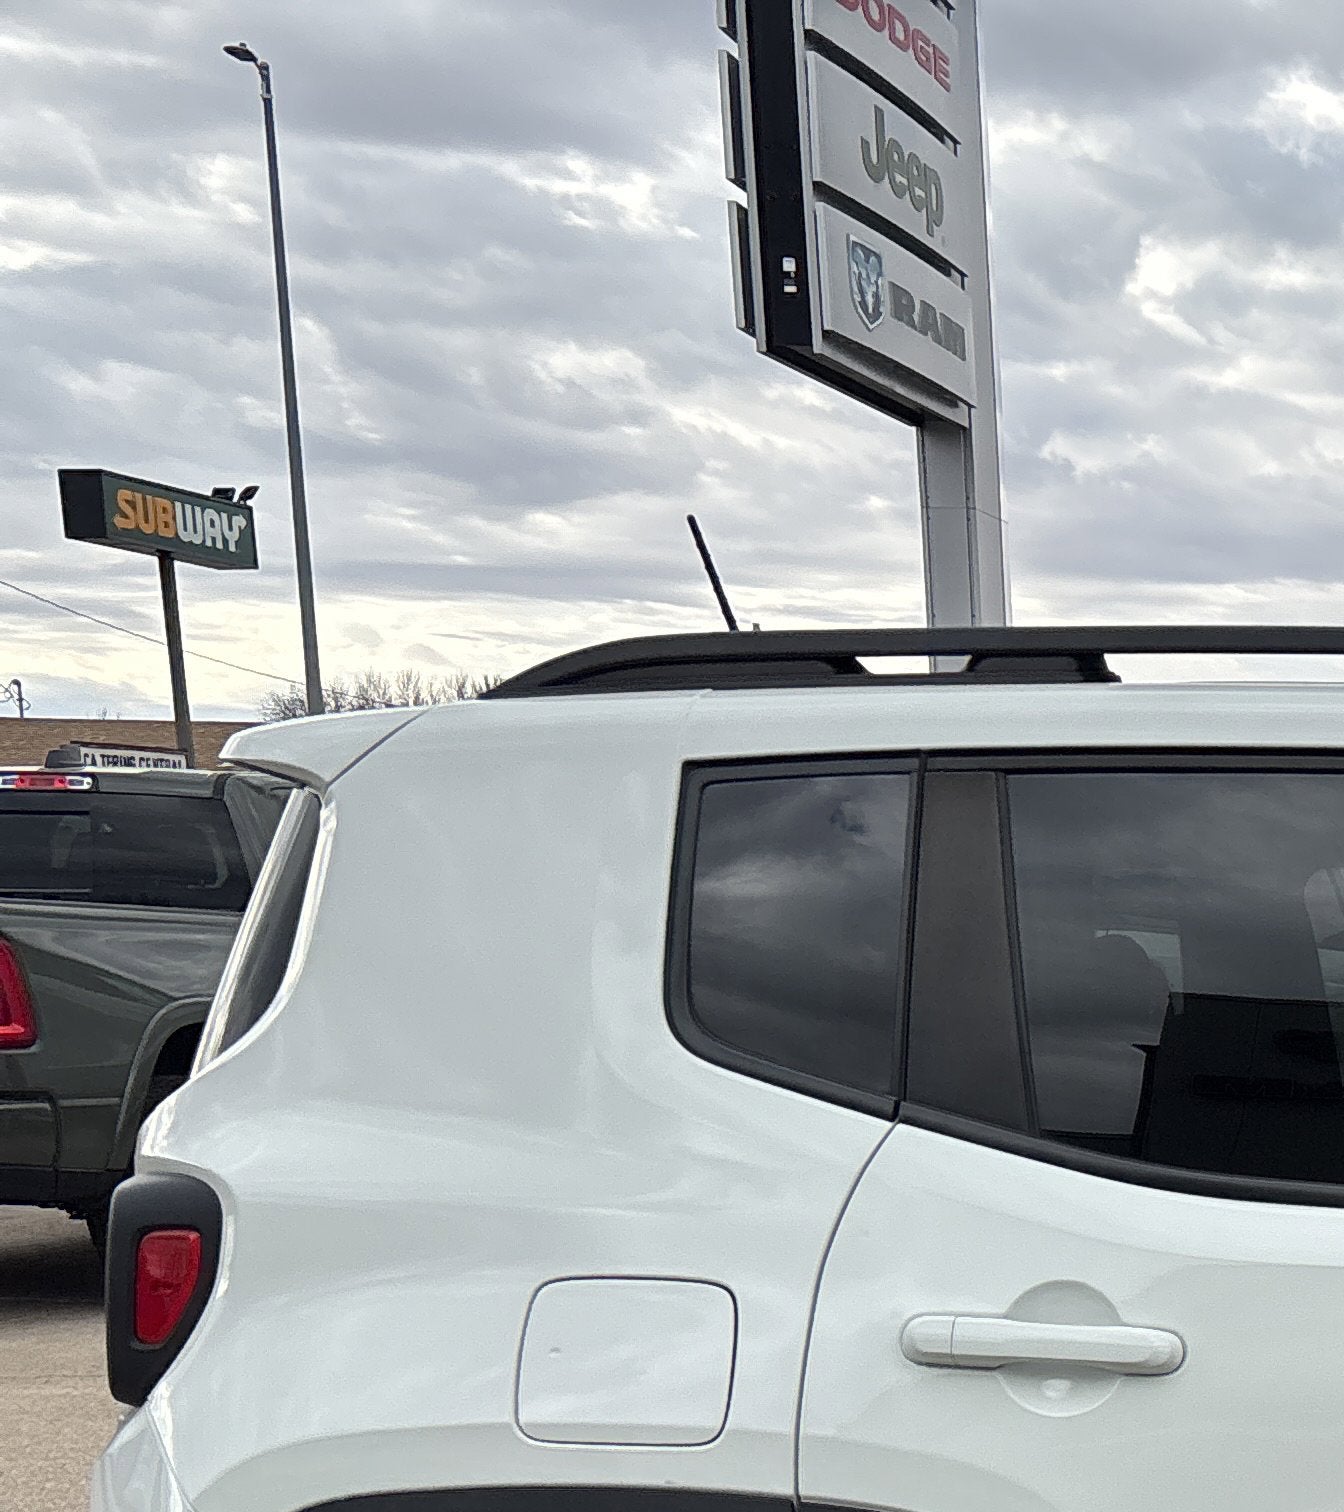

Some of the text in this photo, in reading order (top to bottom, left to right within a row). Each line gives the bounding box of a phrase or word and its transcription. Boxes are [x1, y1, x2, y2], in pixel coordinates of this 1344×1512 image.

[835, 0, 951, 92] ODGE
[861, 104, 944, 238] Jeep
[888, 280, 967, 361] RAM
[112, 489, 248, 553] SUBWAY
